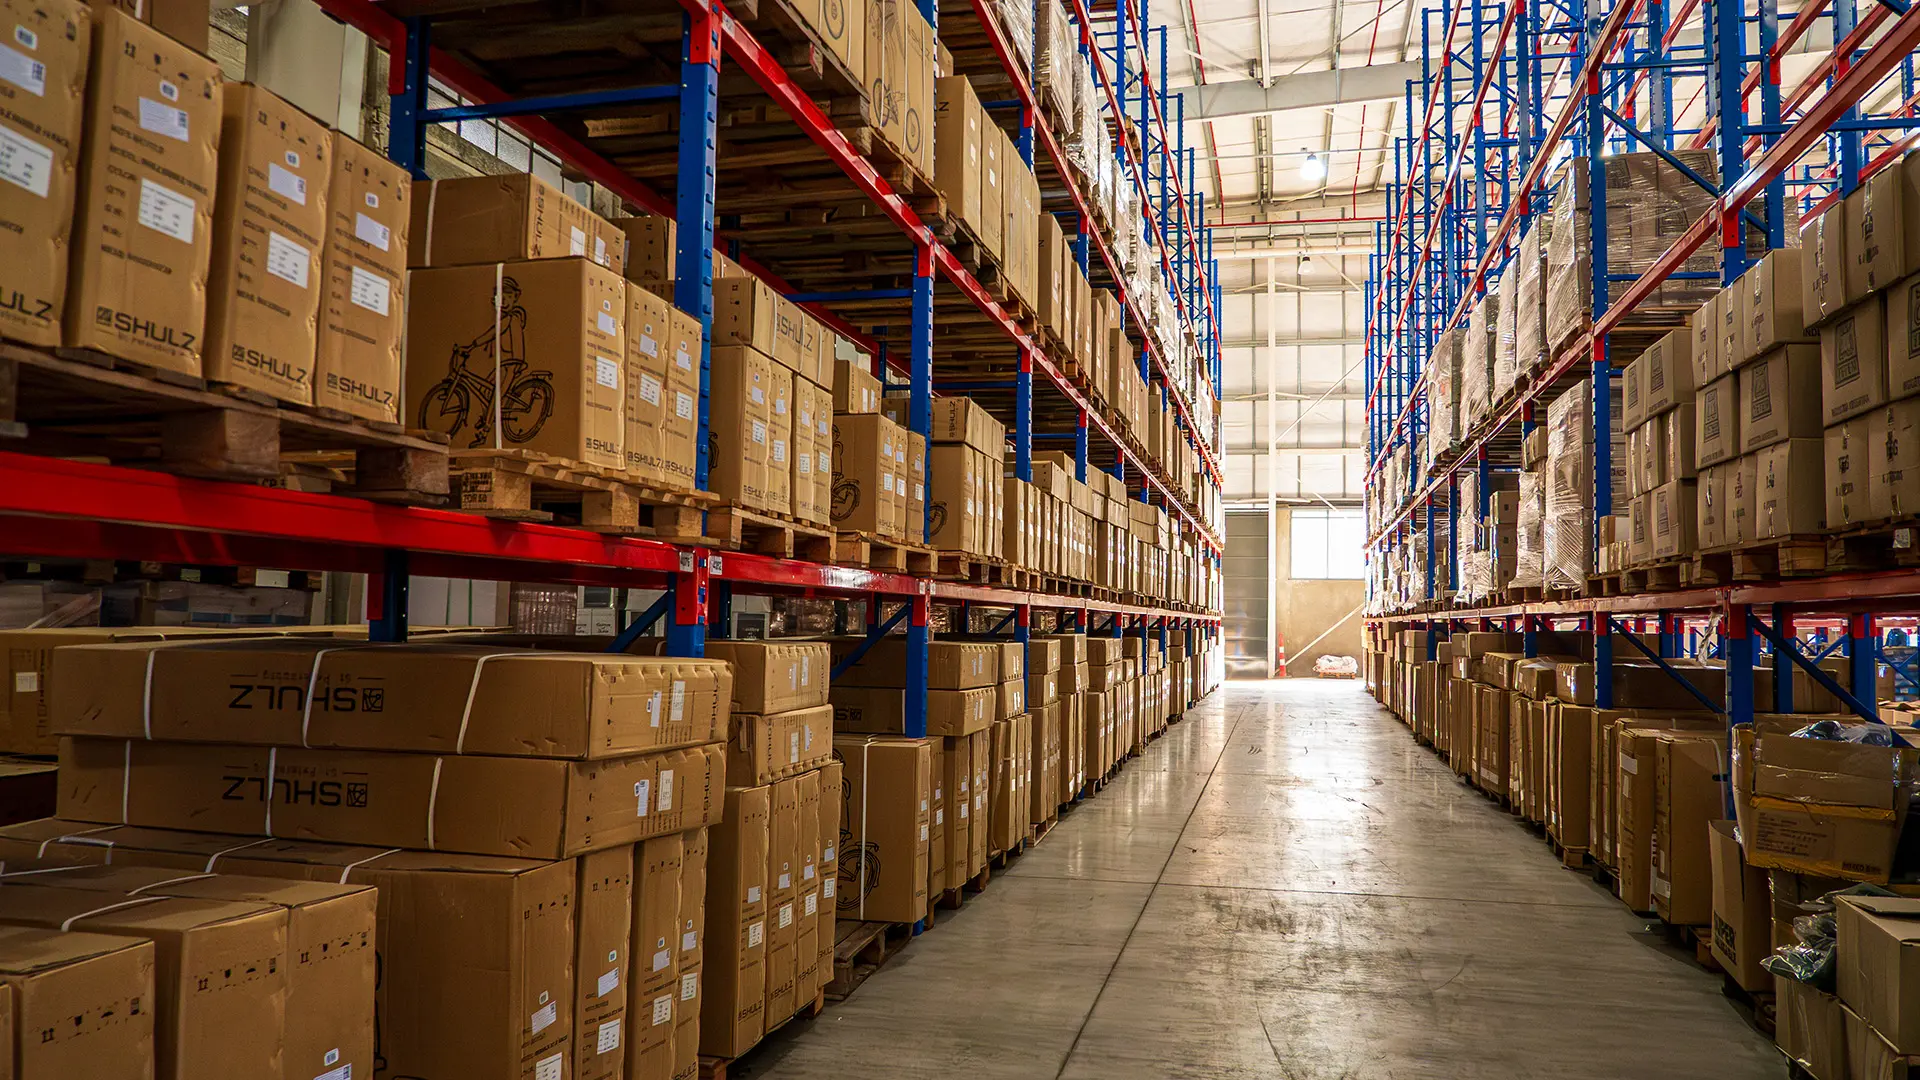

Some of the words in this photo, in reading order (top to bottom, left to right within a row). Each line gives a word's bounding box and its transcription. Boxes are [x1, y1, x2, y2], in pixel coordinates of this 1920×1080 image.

[115, 312, 196, 350] SHULZ
[781, 316, 813, 352] SHUZ
[246, 350, 307, 384] SHULZ
[340, 377, 393, 405] SHULZ
[229, 685, 358, 712] SHULZ
[222, 776, 343, 806] SHULZ
